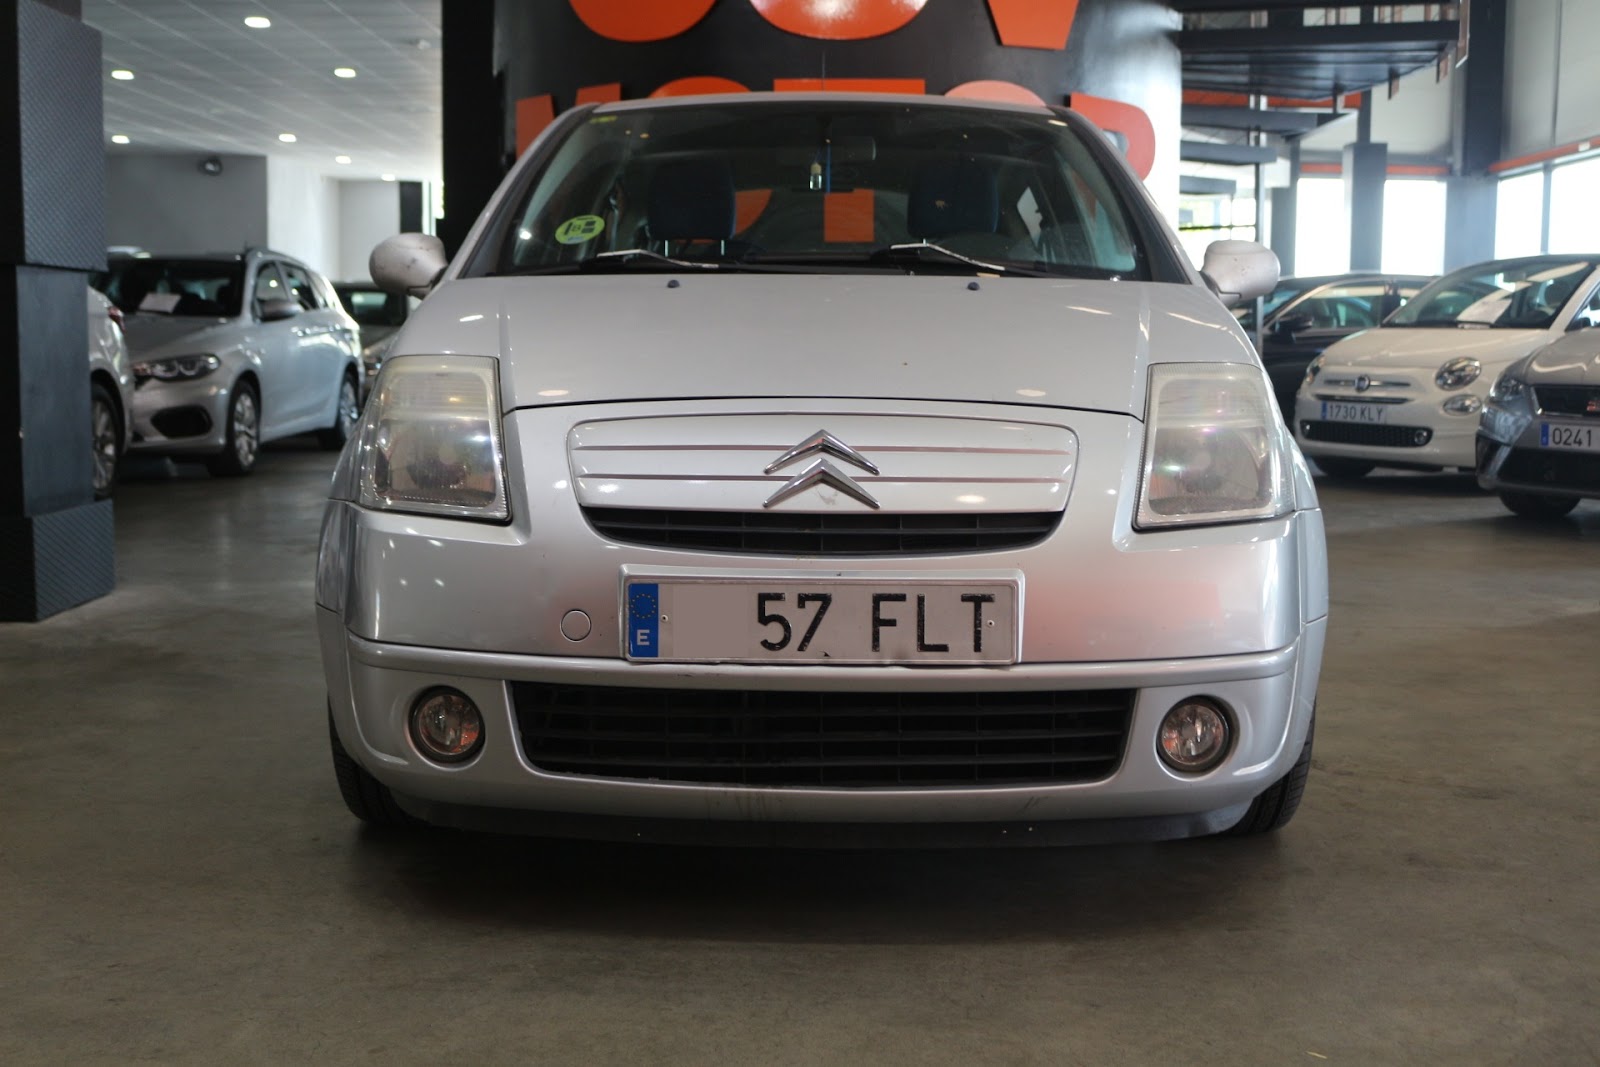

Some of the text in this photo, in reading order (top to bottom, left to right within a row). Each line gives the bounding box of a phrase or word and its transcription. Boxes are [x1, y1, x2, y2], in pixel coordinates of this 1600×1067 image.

[1329, 403, 1383, 421] 1730 KLY
[1552, 427, 1592, 447] 0241
[757, 593, 995, 653] 57 FLT
[636, 629, 650, 646] E
